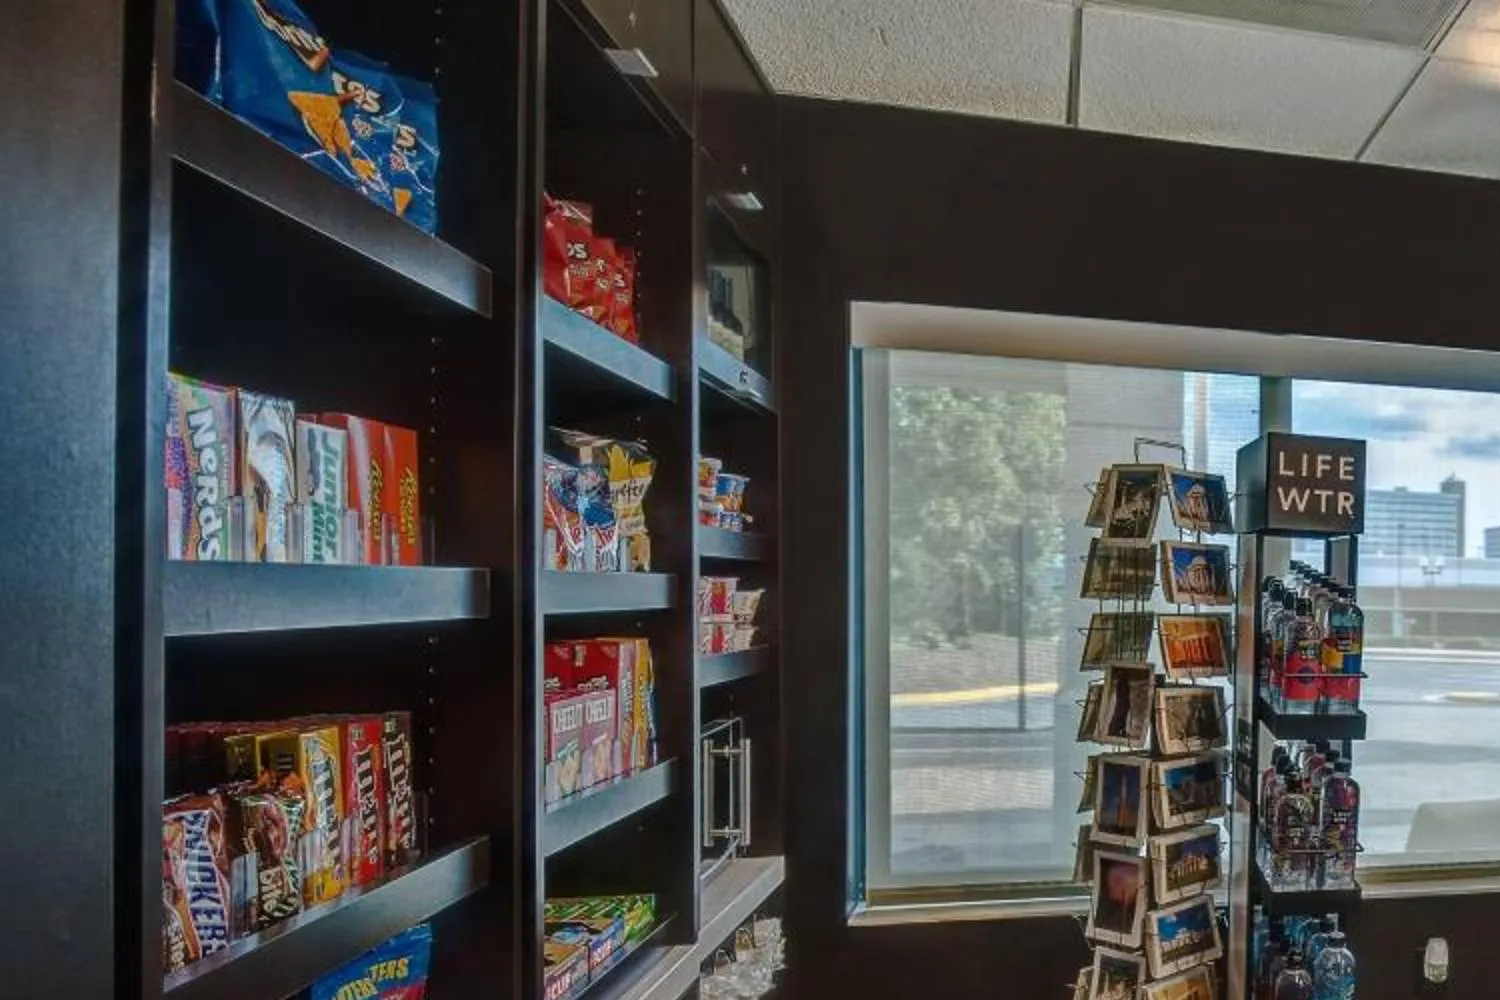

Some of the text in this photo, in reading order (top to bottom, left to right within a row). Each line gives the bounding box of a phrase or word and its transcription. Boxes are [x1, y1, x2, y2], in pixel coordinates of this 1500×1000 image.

[1279, 451, 1356, 480] LIFE
[1277, 486, 1355, 516] WTR
[311, 502, 326, 561] Mint
